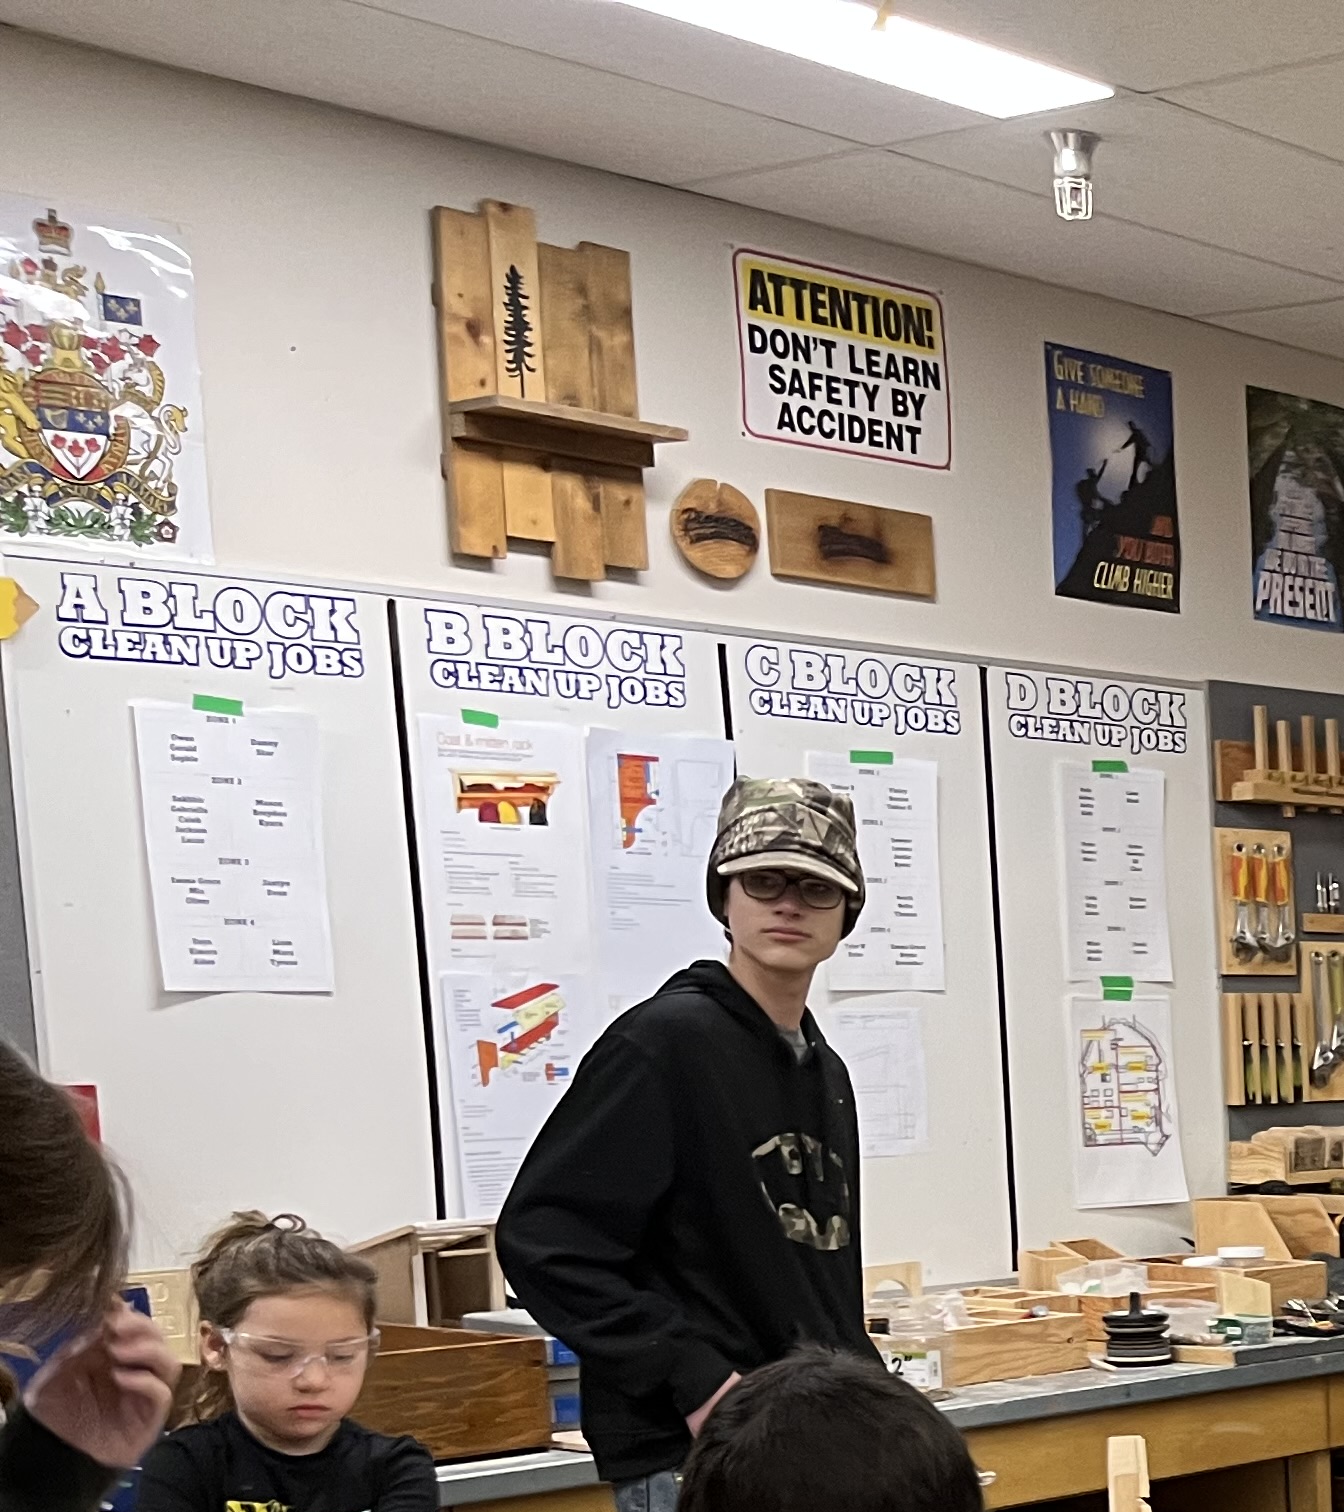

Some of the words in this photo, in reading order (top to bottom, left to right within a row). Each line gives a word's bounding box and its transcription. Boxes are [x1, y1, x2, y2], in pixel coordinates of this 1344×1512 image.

[748, 268, 935, 350] ATTENTION!
[748, 323, 837, 369] DON'T
[848, 344, 941, 391] LEARN
[768, 364, 880, 412] SAFETY
[891, 387, 927, 421] BY
[777, 402, 922, 454] ACCIDENT
[1094, 561, 1131, 592] CLIMB
[1132, 567, 1174, 600] HIGHER
[1255, 571, 1336, 622] PRESENT
[57, 572, 108, 624] A
[118, 578, 360, 645] BLOCK
[58, 626, 200, 666] CLEAN
[205, 637, 262, 669] UP
[267, 641, 364, 679] JOBS
[424, 608, 472, 656] B
[482, 614, 686, 677] BLOCK
[430, 659, 550, 697] CLEAN
[553, 670, 602, 700] UP
[606, 675, 687, 709] JOBS
[745, 645, 781, 687] C
[789, 649, 957, 707] BLOCK
[1005, 672, 1037, 711] D
[1046, 677, 1187, 729] BLOCK
[749, 688, 848, 723] CLEAN
[851, 699, 891, 727] UP
[895, 704, 961, 735] JOBS
[1008, 713, 1091, 745] CLEAN
[1094, 722, 1128, 748] UP
[1131, 726, 1187, 755] JOBS
